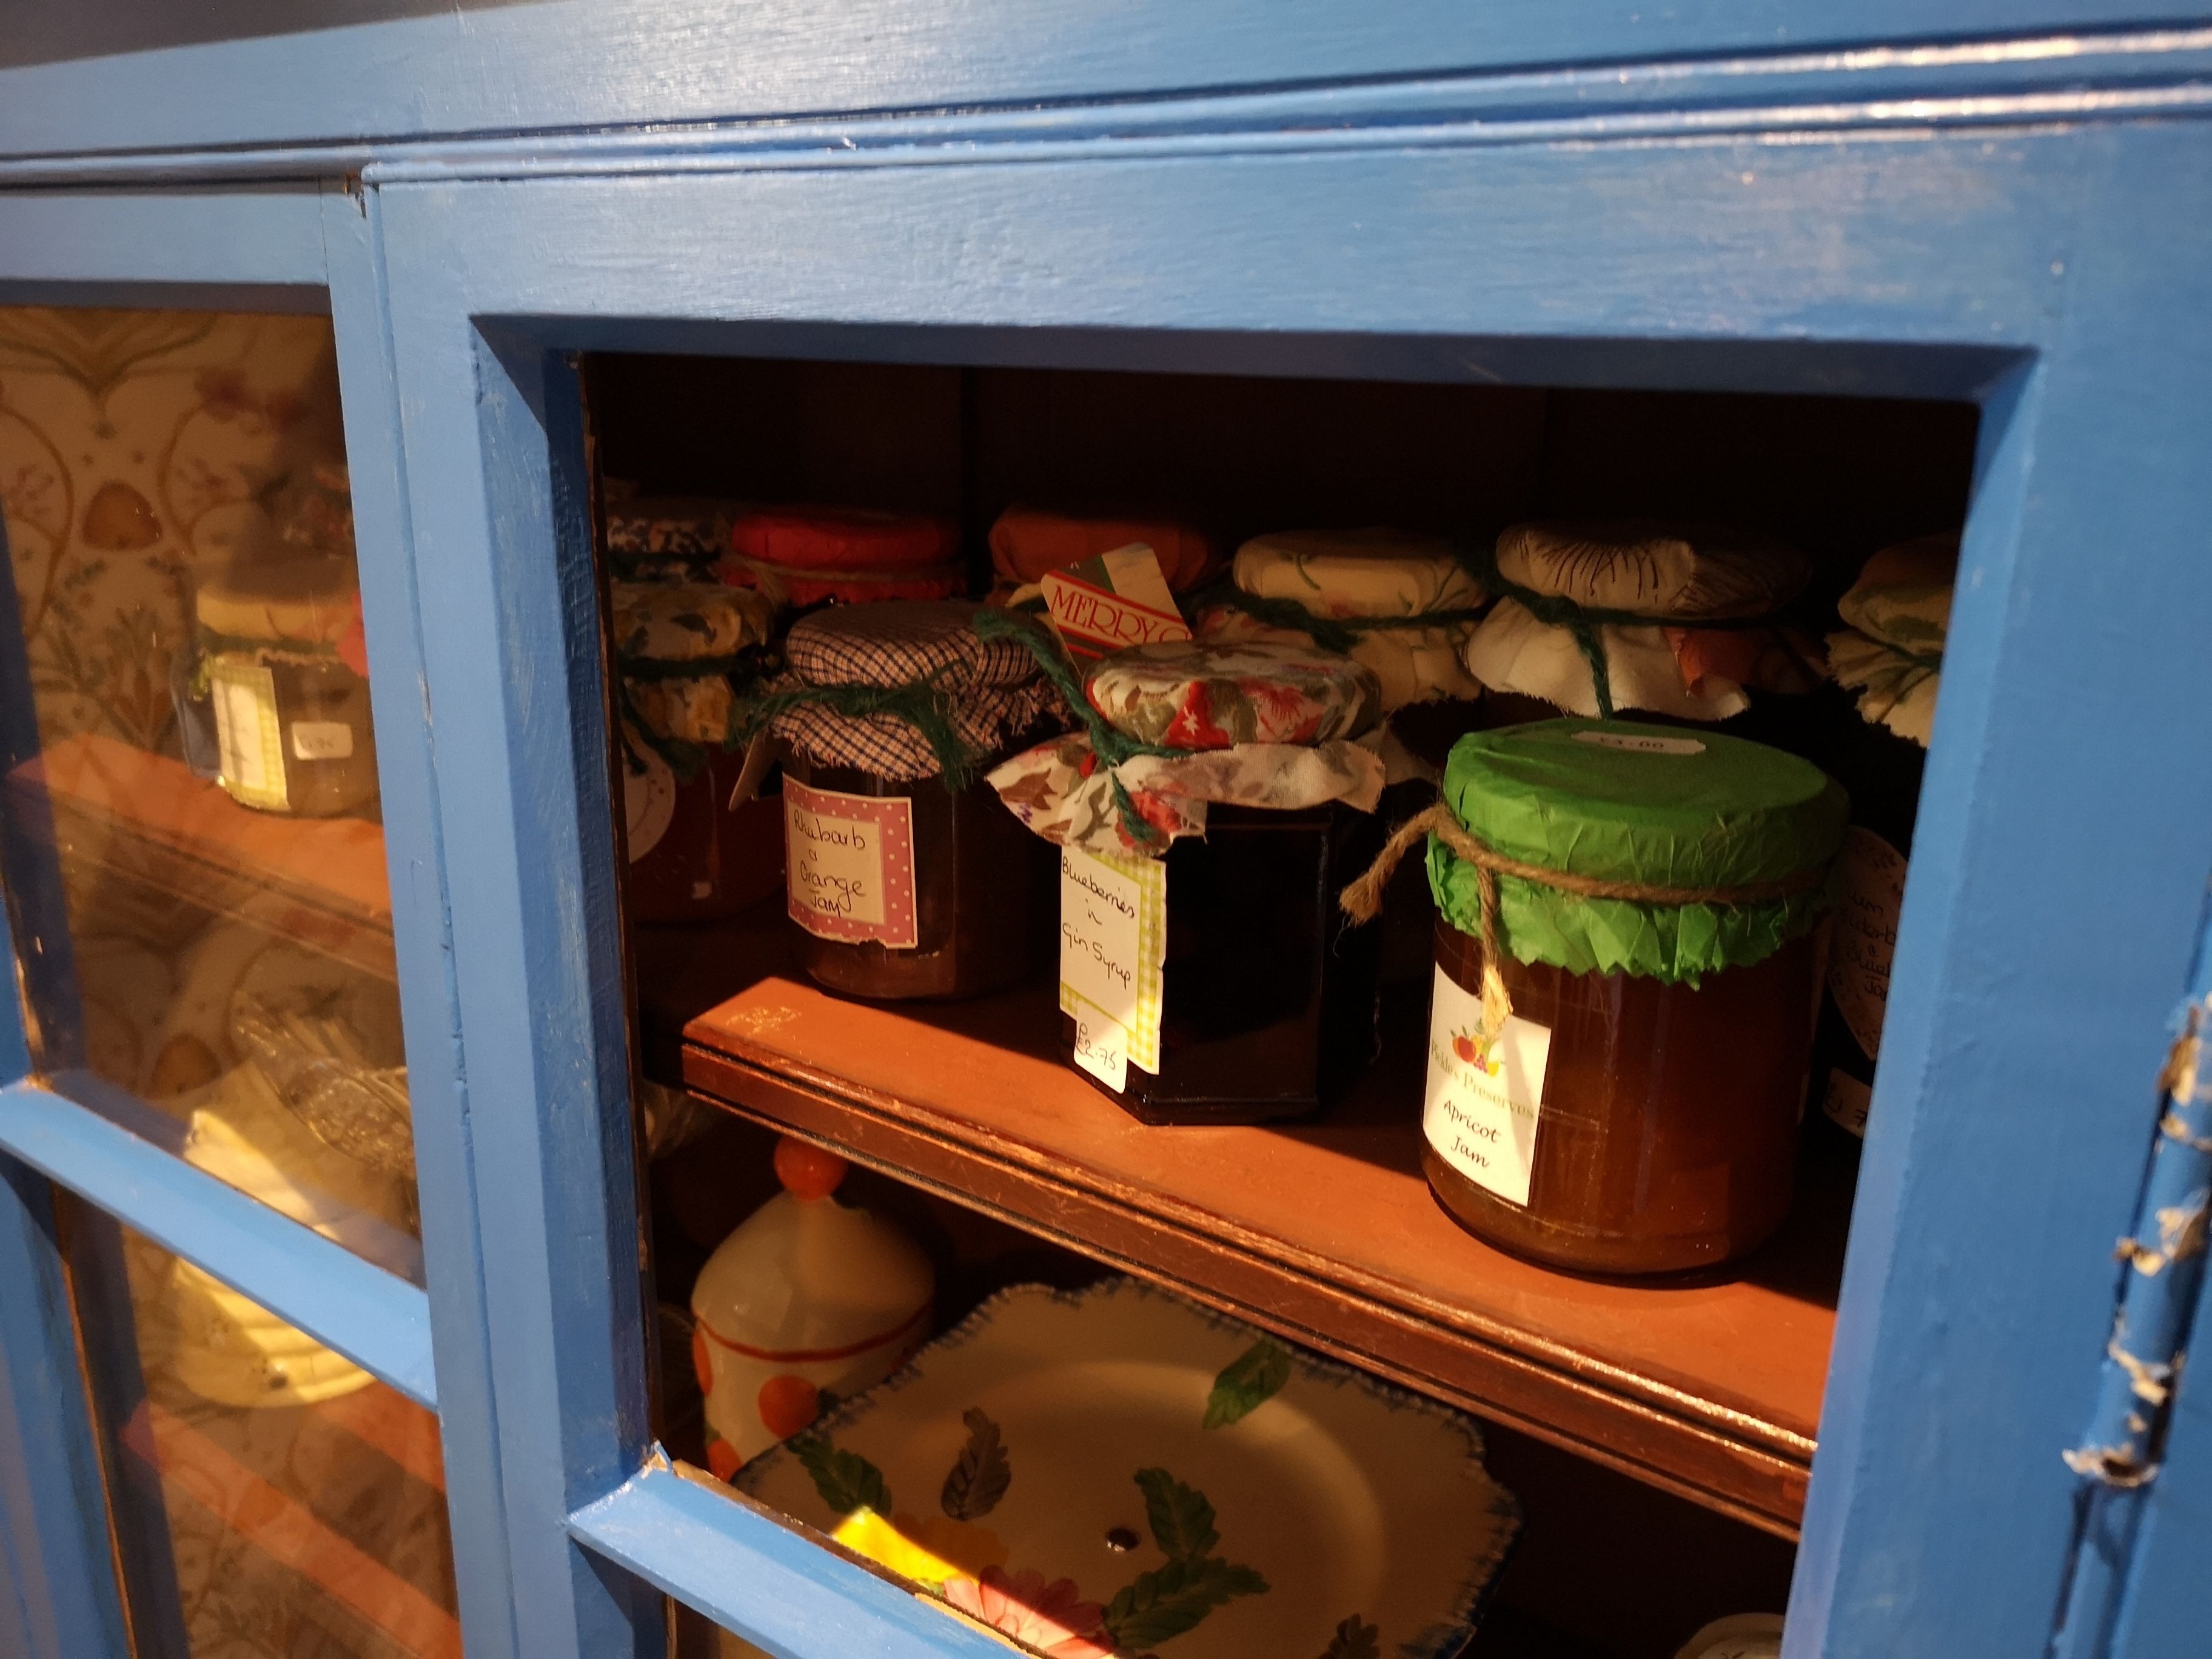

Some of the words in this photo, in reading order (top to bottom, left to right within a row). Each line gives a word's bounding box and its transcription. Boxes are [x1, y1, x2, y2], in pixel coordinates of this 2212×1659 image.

[1051, 585, 1158, 645] MERRY
[794, 808, 866, 851] Rhubarb
[800, 860, 867, 913] Orange
[809, 888, 842, 919] Jam
[1085, 897, 1102, 925] in
[1062, 922, 1088, 951] Gin
[1093, 942, 1131, 990] Syrup
[1076, 1022, 1116, 1071] £2.75
[1443, 1099, 1503, 1144] Apricot
[1450, 1135, 1490, 1168] Jam
